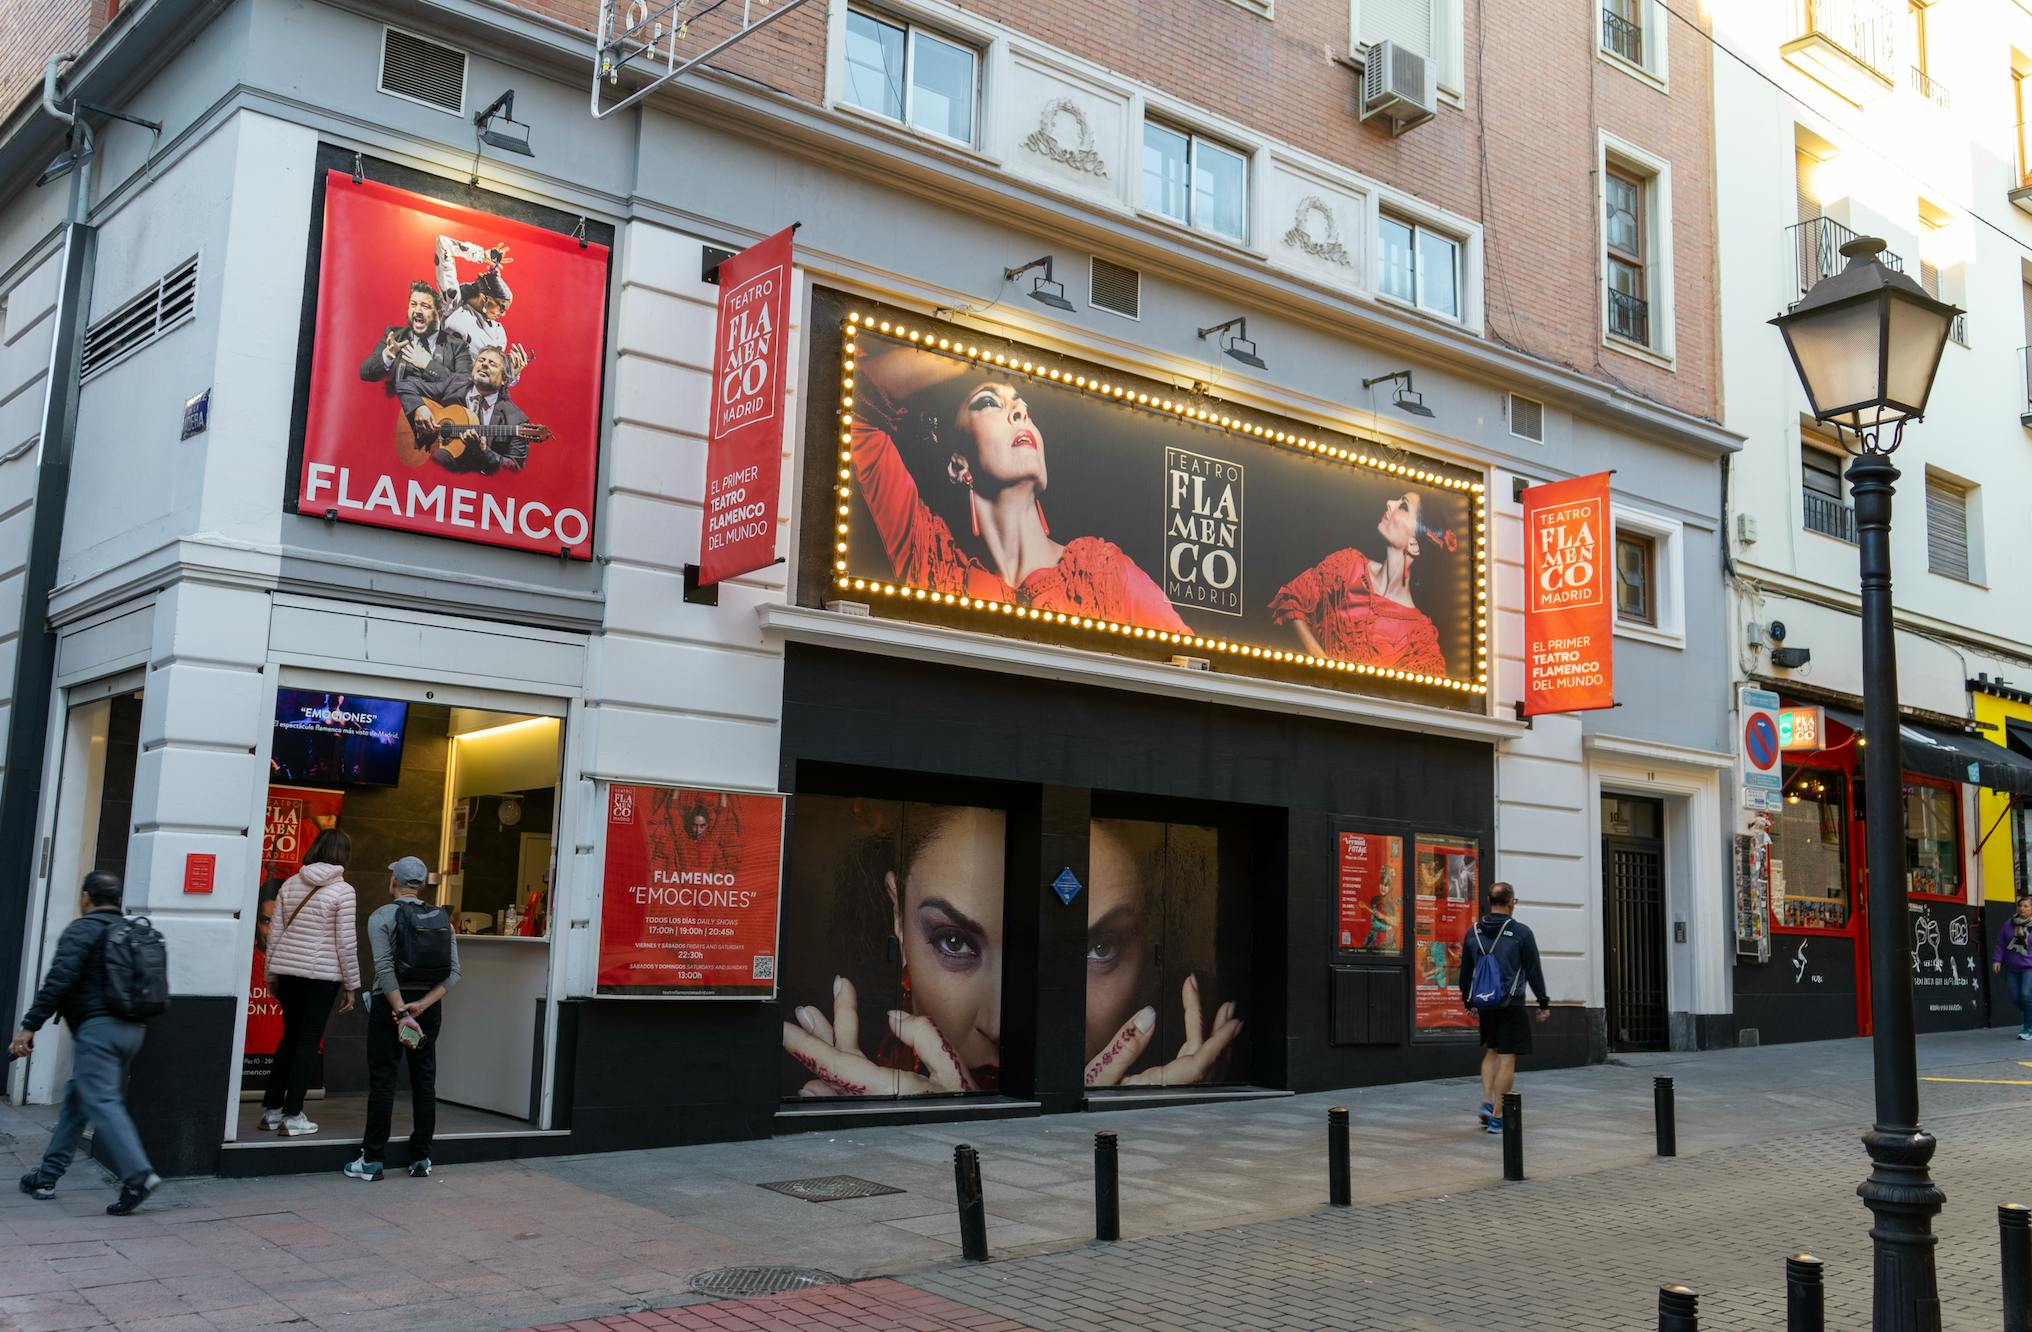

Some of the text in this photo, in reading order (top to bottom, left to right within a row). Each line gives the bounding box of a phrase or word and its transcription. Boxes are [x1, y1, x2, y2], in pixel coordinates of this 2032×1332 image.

[730, 280, 773, 313] TEATRO
[727, 302, 772, 351] FLA
[724, 333, 772, 373] MEN
[723, 358, 767, 404] CO
[723, 397, 764, 426] MADRID
[1168, 451, 1238, 482] TEATRO
[711, 466, 758, 495] EL PRIMER
[306, 462, 588, 544] FLAMENCO
[710, 488, 746, 513] TEATRO
[1170, 469, 1239, 522] FLA
[709, 502, 765, 532] FLAMENCO
[1540, 506, 1591, 525] TEATRO
[709, 520, 767, 550] DEL MUNDO
[1168, 512, 1237, 549] MEN
[1540, 521, 1595, 553] FLA
[1541, 544, 1595, 568] MEN
[1169, 542, 1237, 589] CO
[1540, 561, 1593, 591] CO
[1169, 581, 1238, 607] MADRID
[1541, 588, 1592, 605] MADRID
[1533, 635, 1590, 653] EL PRIMER
[1532, 650, 1580, 665] TEATRO
[1532, 661, 1600, 678] FLAMENCO
[1533, 674, 1603, 691] DEL MUNDO
[301, 707, 377, 724] “EMOCIONES”
[1796, 716, 1814, 730] FLA
[279, 721, 315, 730] espectáculo
[315, 724, 342, 733] flamenco
[343, 727, 354, 735] más
[355, 729, 368, 737] visto
[1796, 731, 1814, 740] CO
[615, 793, 632, 804] FLA
[613, 807, 631, 817] CO
[263, 834, 296, 852] CO
[262, 851, 296, 860] ADRID
[654, 870, 735, 886] FLAMENCO
[645, 916, 738, 926] TODOS LOS DÍAS DAILY SHOWS
[649, 926, 674, 935] 17:00h
[680, 927, 703, 935] 19:00h
[708, 927, 734, 936] 20:45h
[678, 951, 703, 959] 22:30h
[678, 971, 702, 979] 13:00h
[270, 1004, 278, 1015] Y
